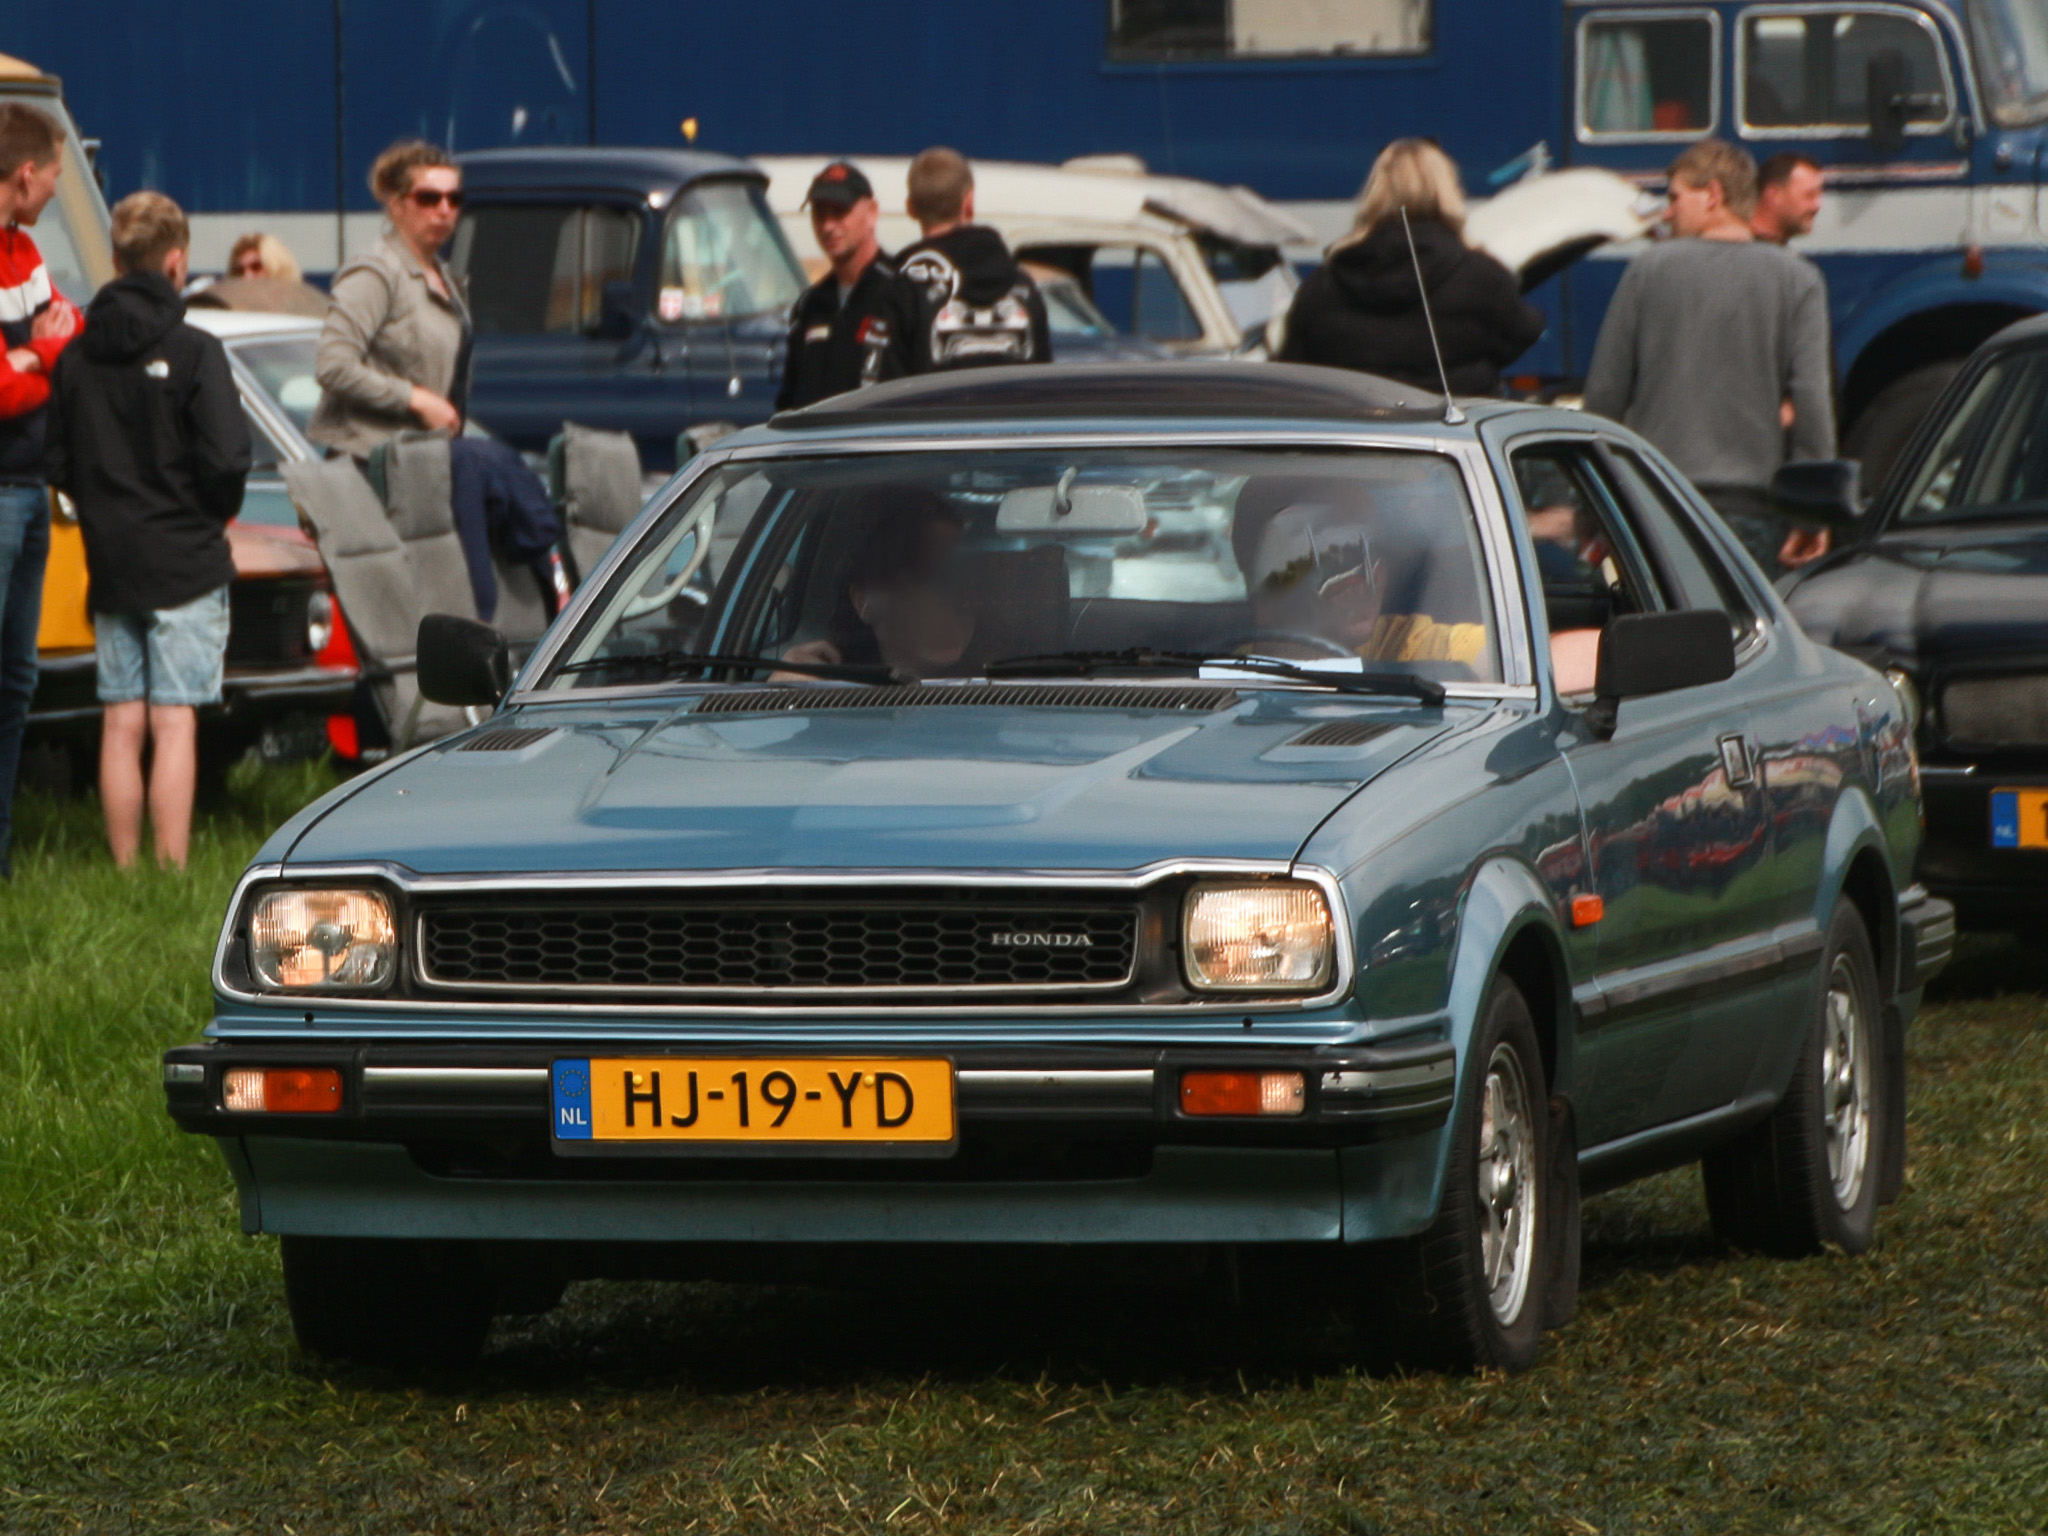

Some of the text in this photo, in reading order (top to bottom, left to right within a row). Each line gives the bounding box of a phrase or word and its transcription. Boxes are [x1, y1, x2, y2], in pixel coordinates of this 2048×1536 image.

[991, 932, 1093, 946] HONDA
[624, 1070, 914, 1128] HJ-19-YD
[560, 1108, 587, 1125] NL
